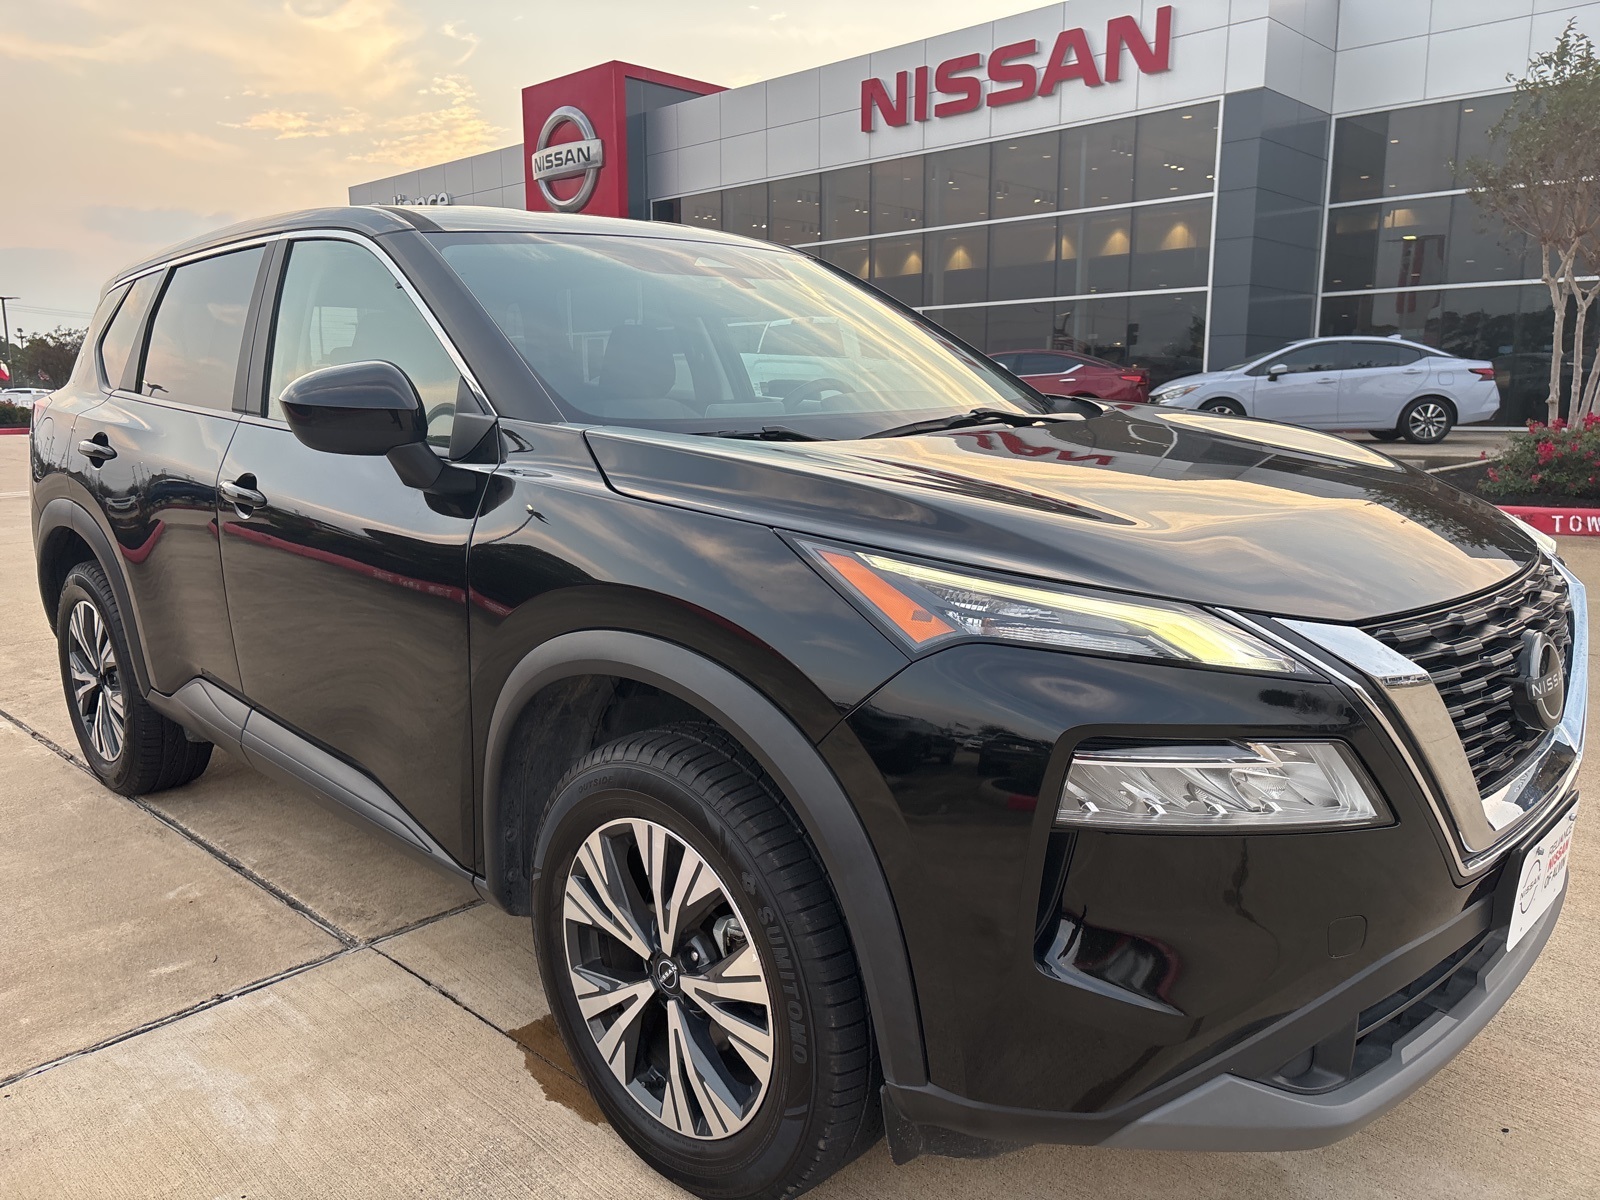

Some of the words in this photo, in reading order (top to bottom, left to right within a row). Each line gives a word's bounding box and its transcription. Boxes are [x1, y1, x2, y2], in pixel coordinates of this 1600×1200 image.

[861, 5, 1173, 132] NISSAN
[534, 145, 592, 173] NISSAN
[578, 775, 614, 794] OUTSIDE
[757, 906, 808, 1064] SUMITOMO
